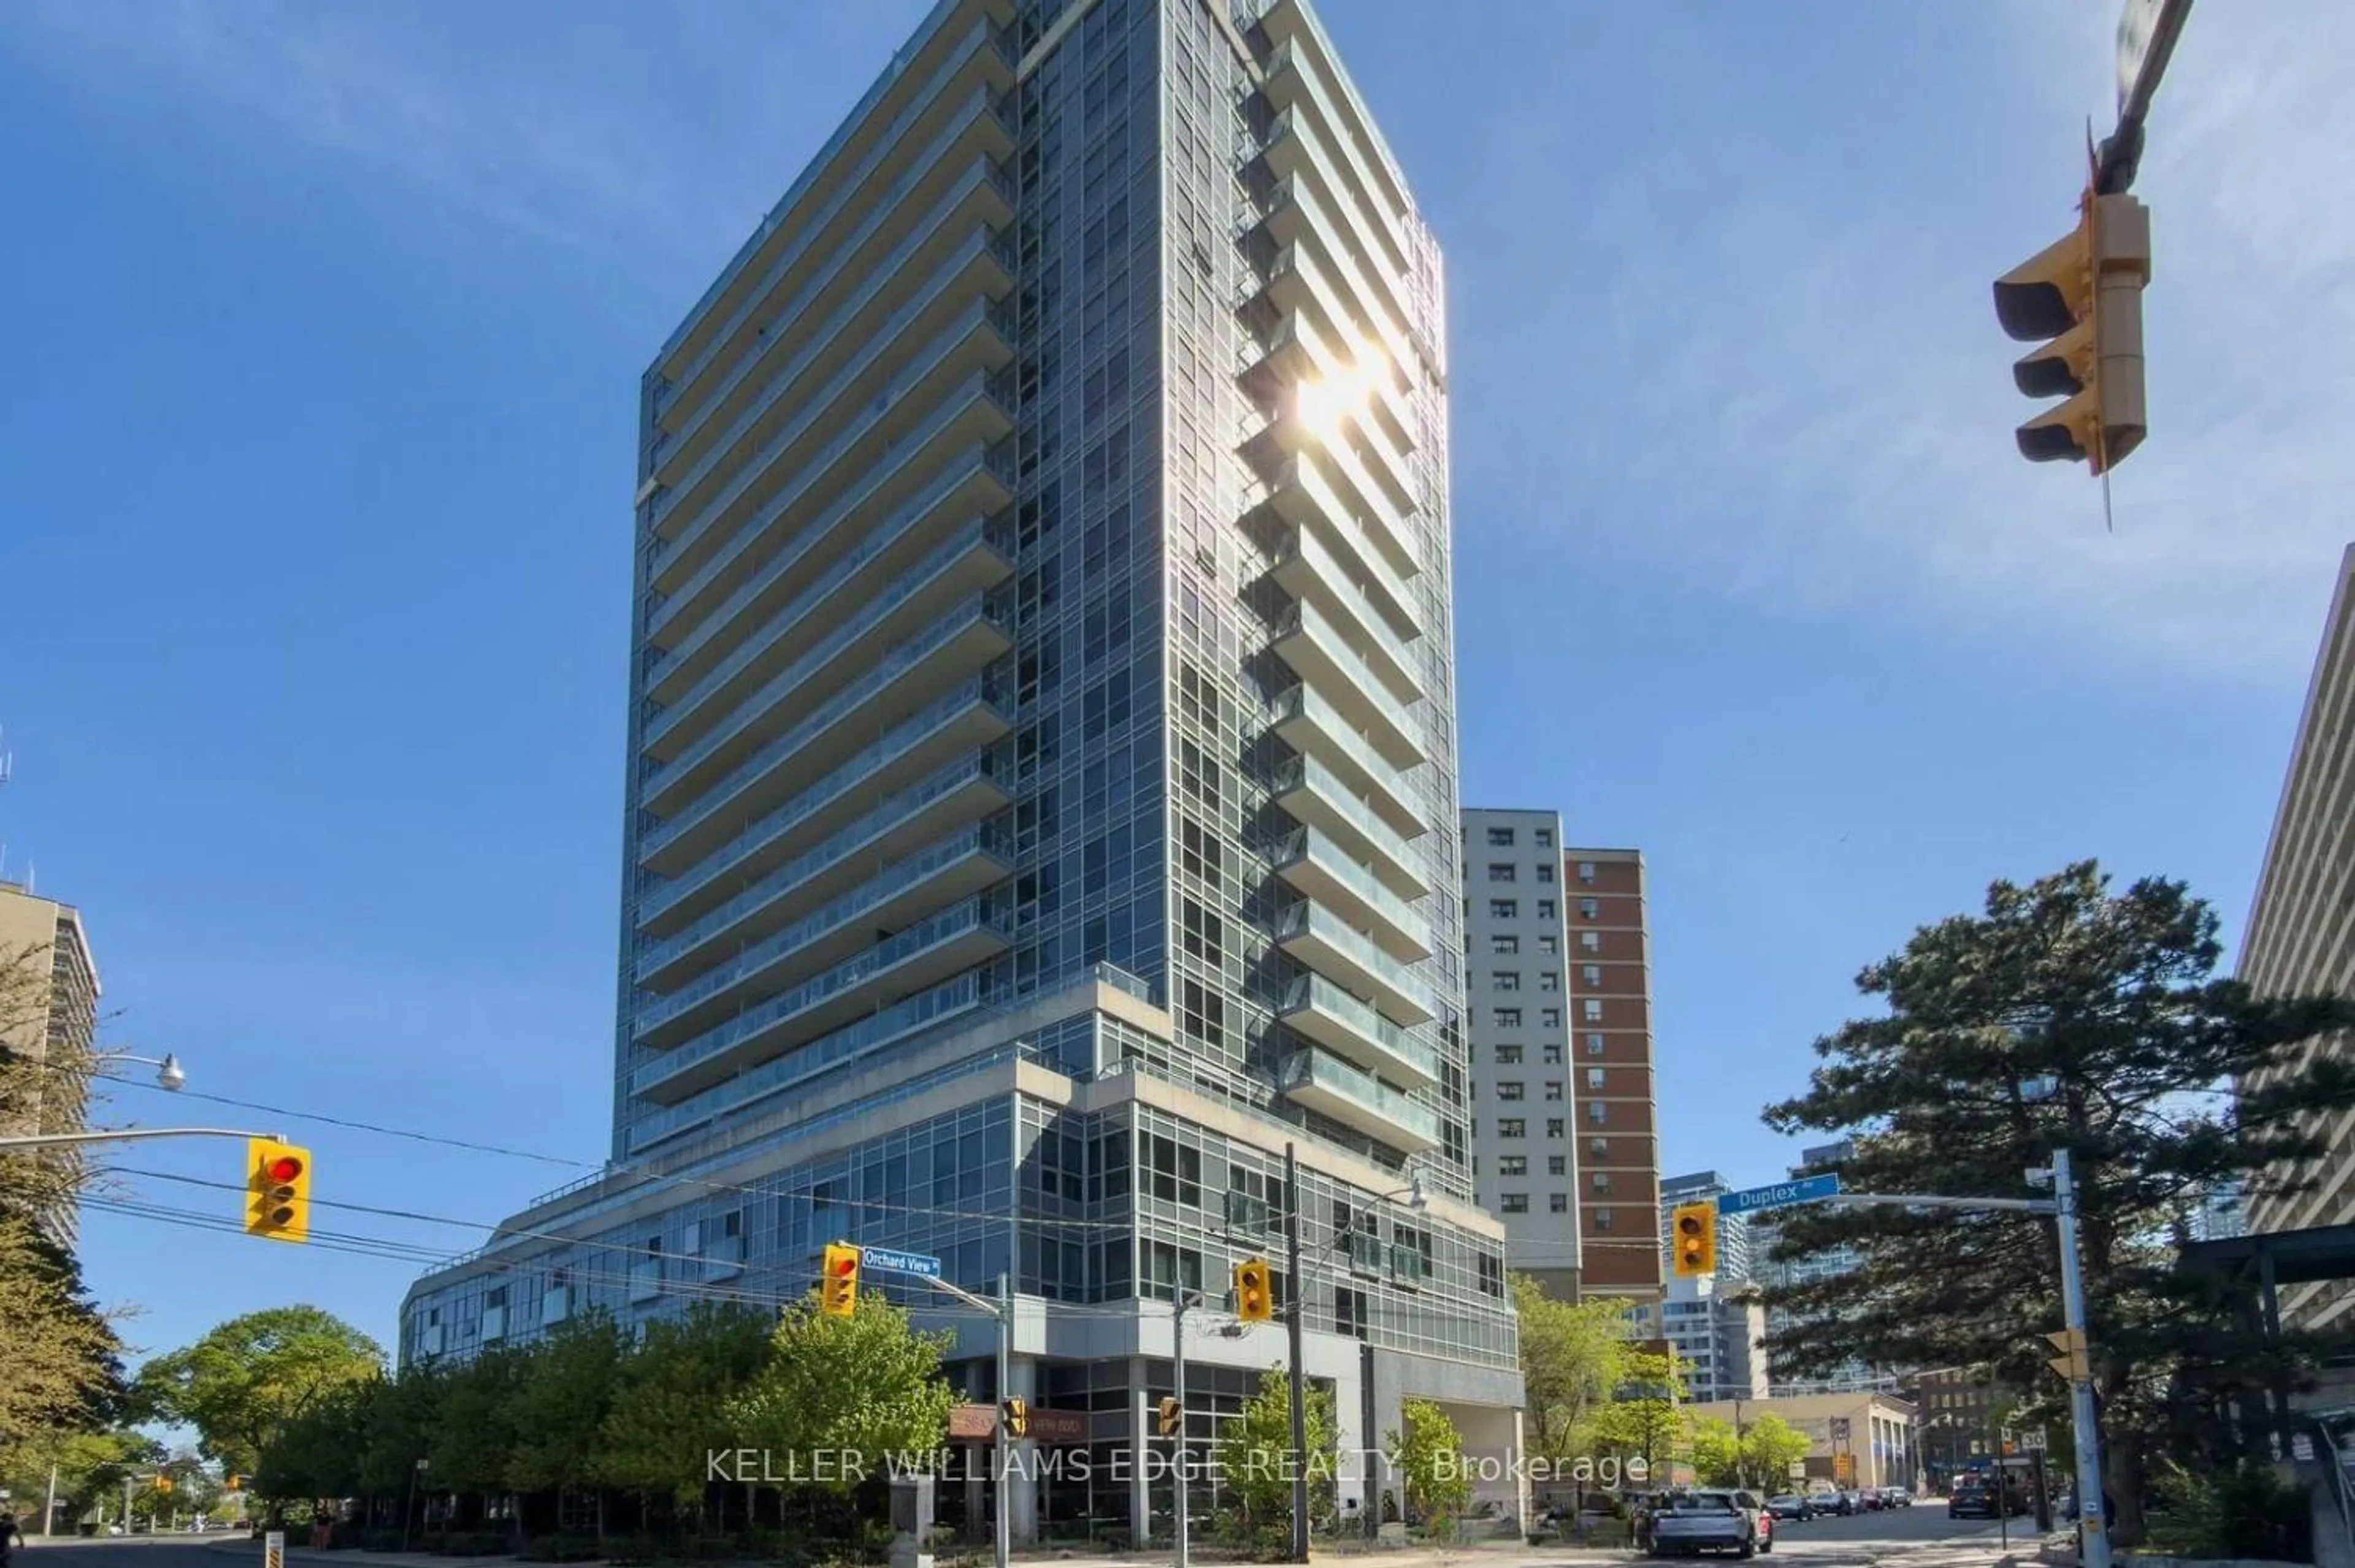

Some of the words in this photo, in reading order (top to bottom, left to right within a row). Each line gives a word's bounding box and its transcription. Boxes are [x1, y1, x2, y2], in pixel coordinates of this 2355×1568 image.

[1739, 1187, 1797, 1207] Duplex
[866, 1250, 906, 1269] Orchard
[908, 1256, 930, 1272] View
[2024, 1435, 2044, 1446] 30
